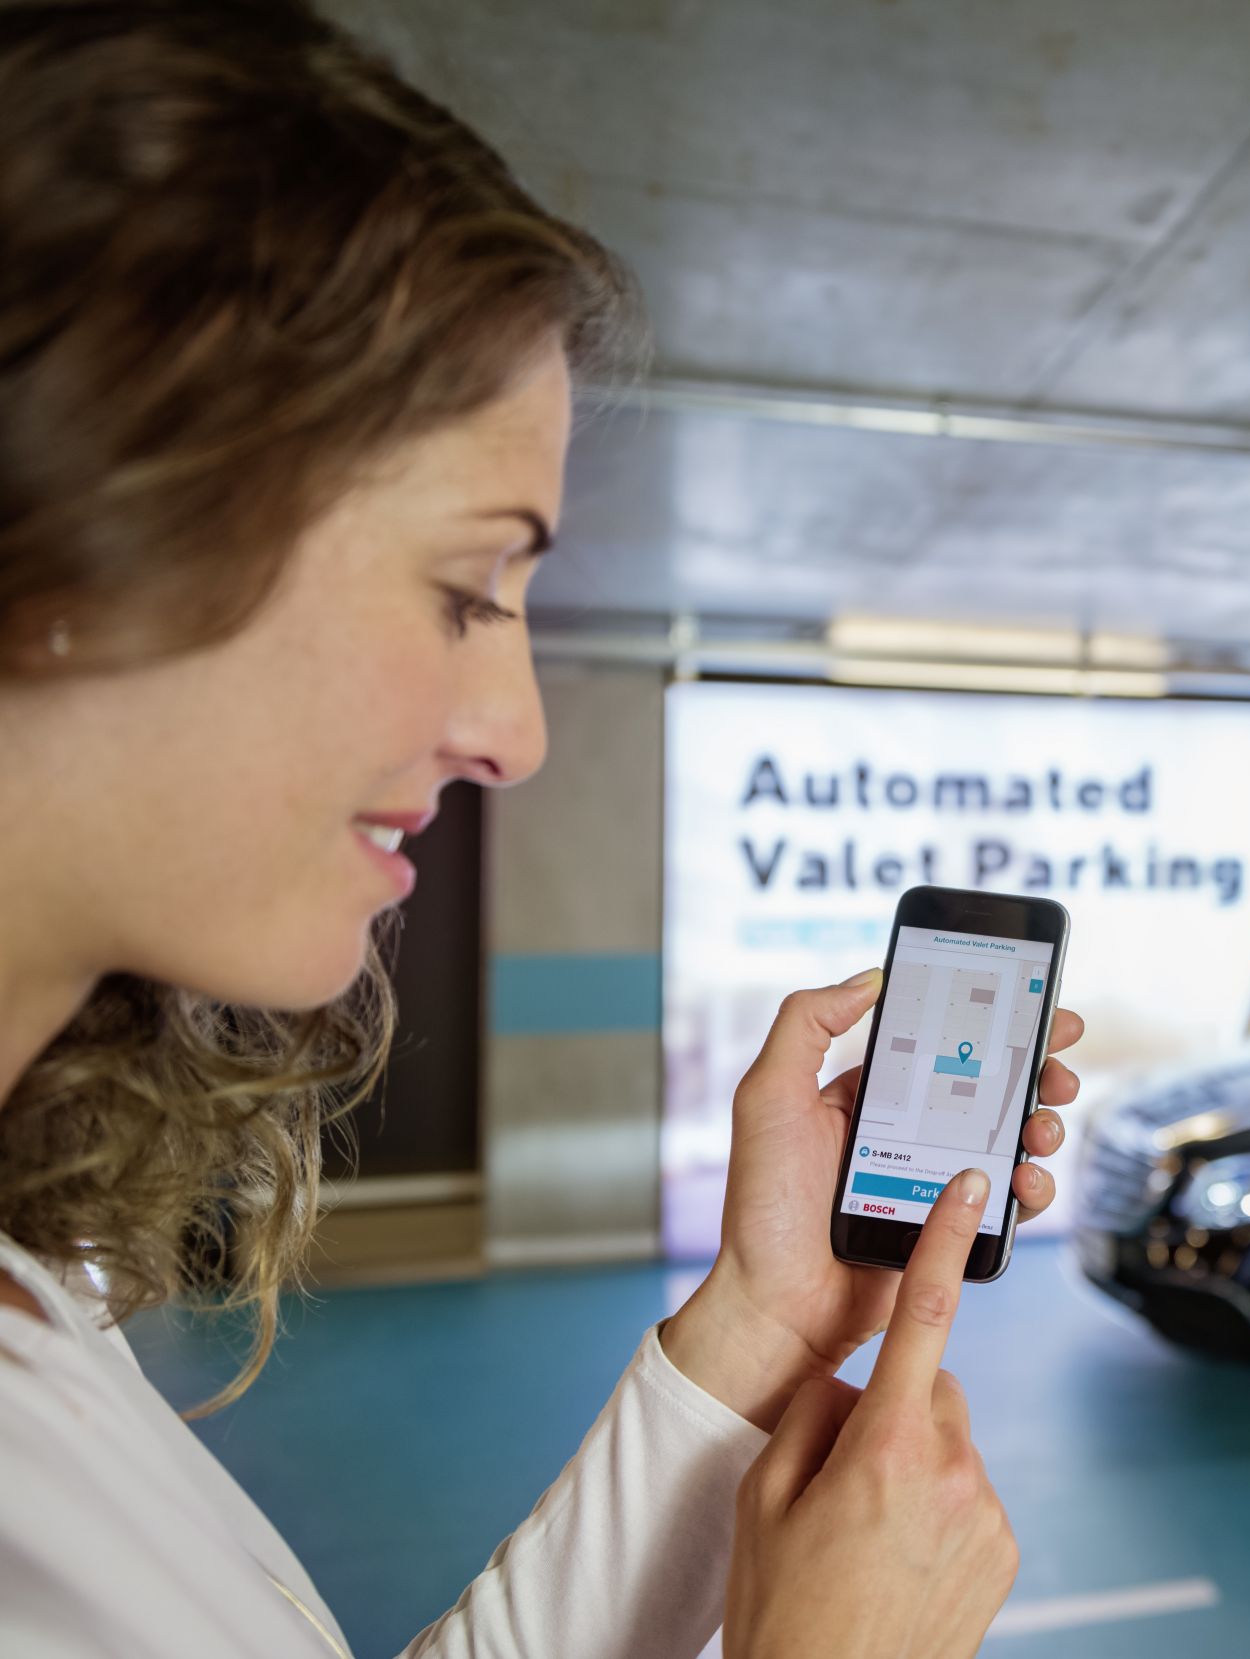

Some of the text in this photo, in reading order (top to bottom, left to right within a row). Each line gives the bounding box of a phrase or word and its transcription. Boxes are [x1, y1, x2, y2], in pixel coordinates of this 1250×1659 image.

[742, 754, 1153, 813] Automated
[742, 837, 1243, 904] Valet Parking
[934, 936, 1016, 953] Automated Valet Parking
[872, 1150, 912, 1162] S-MB 2412
[863, 1203, 896, 1216] BOSCH
